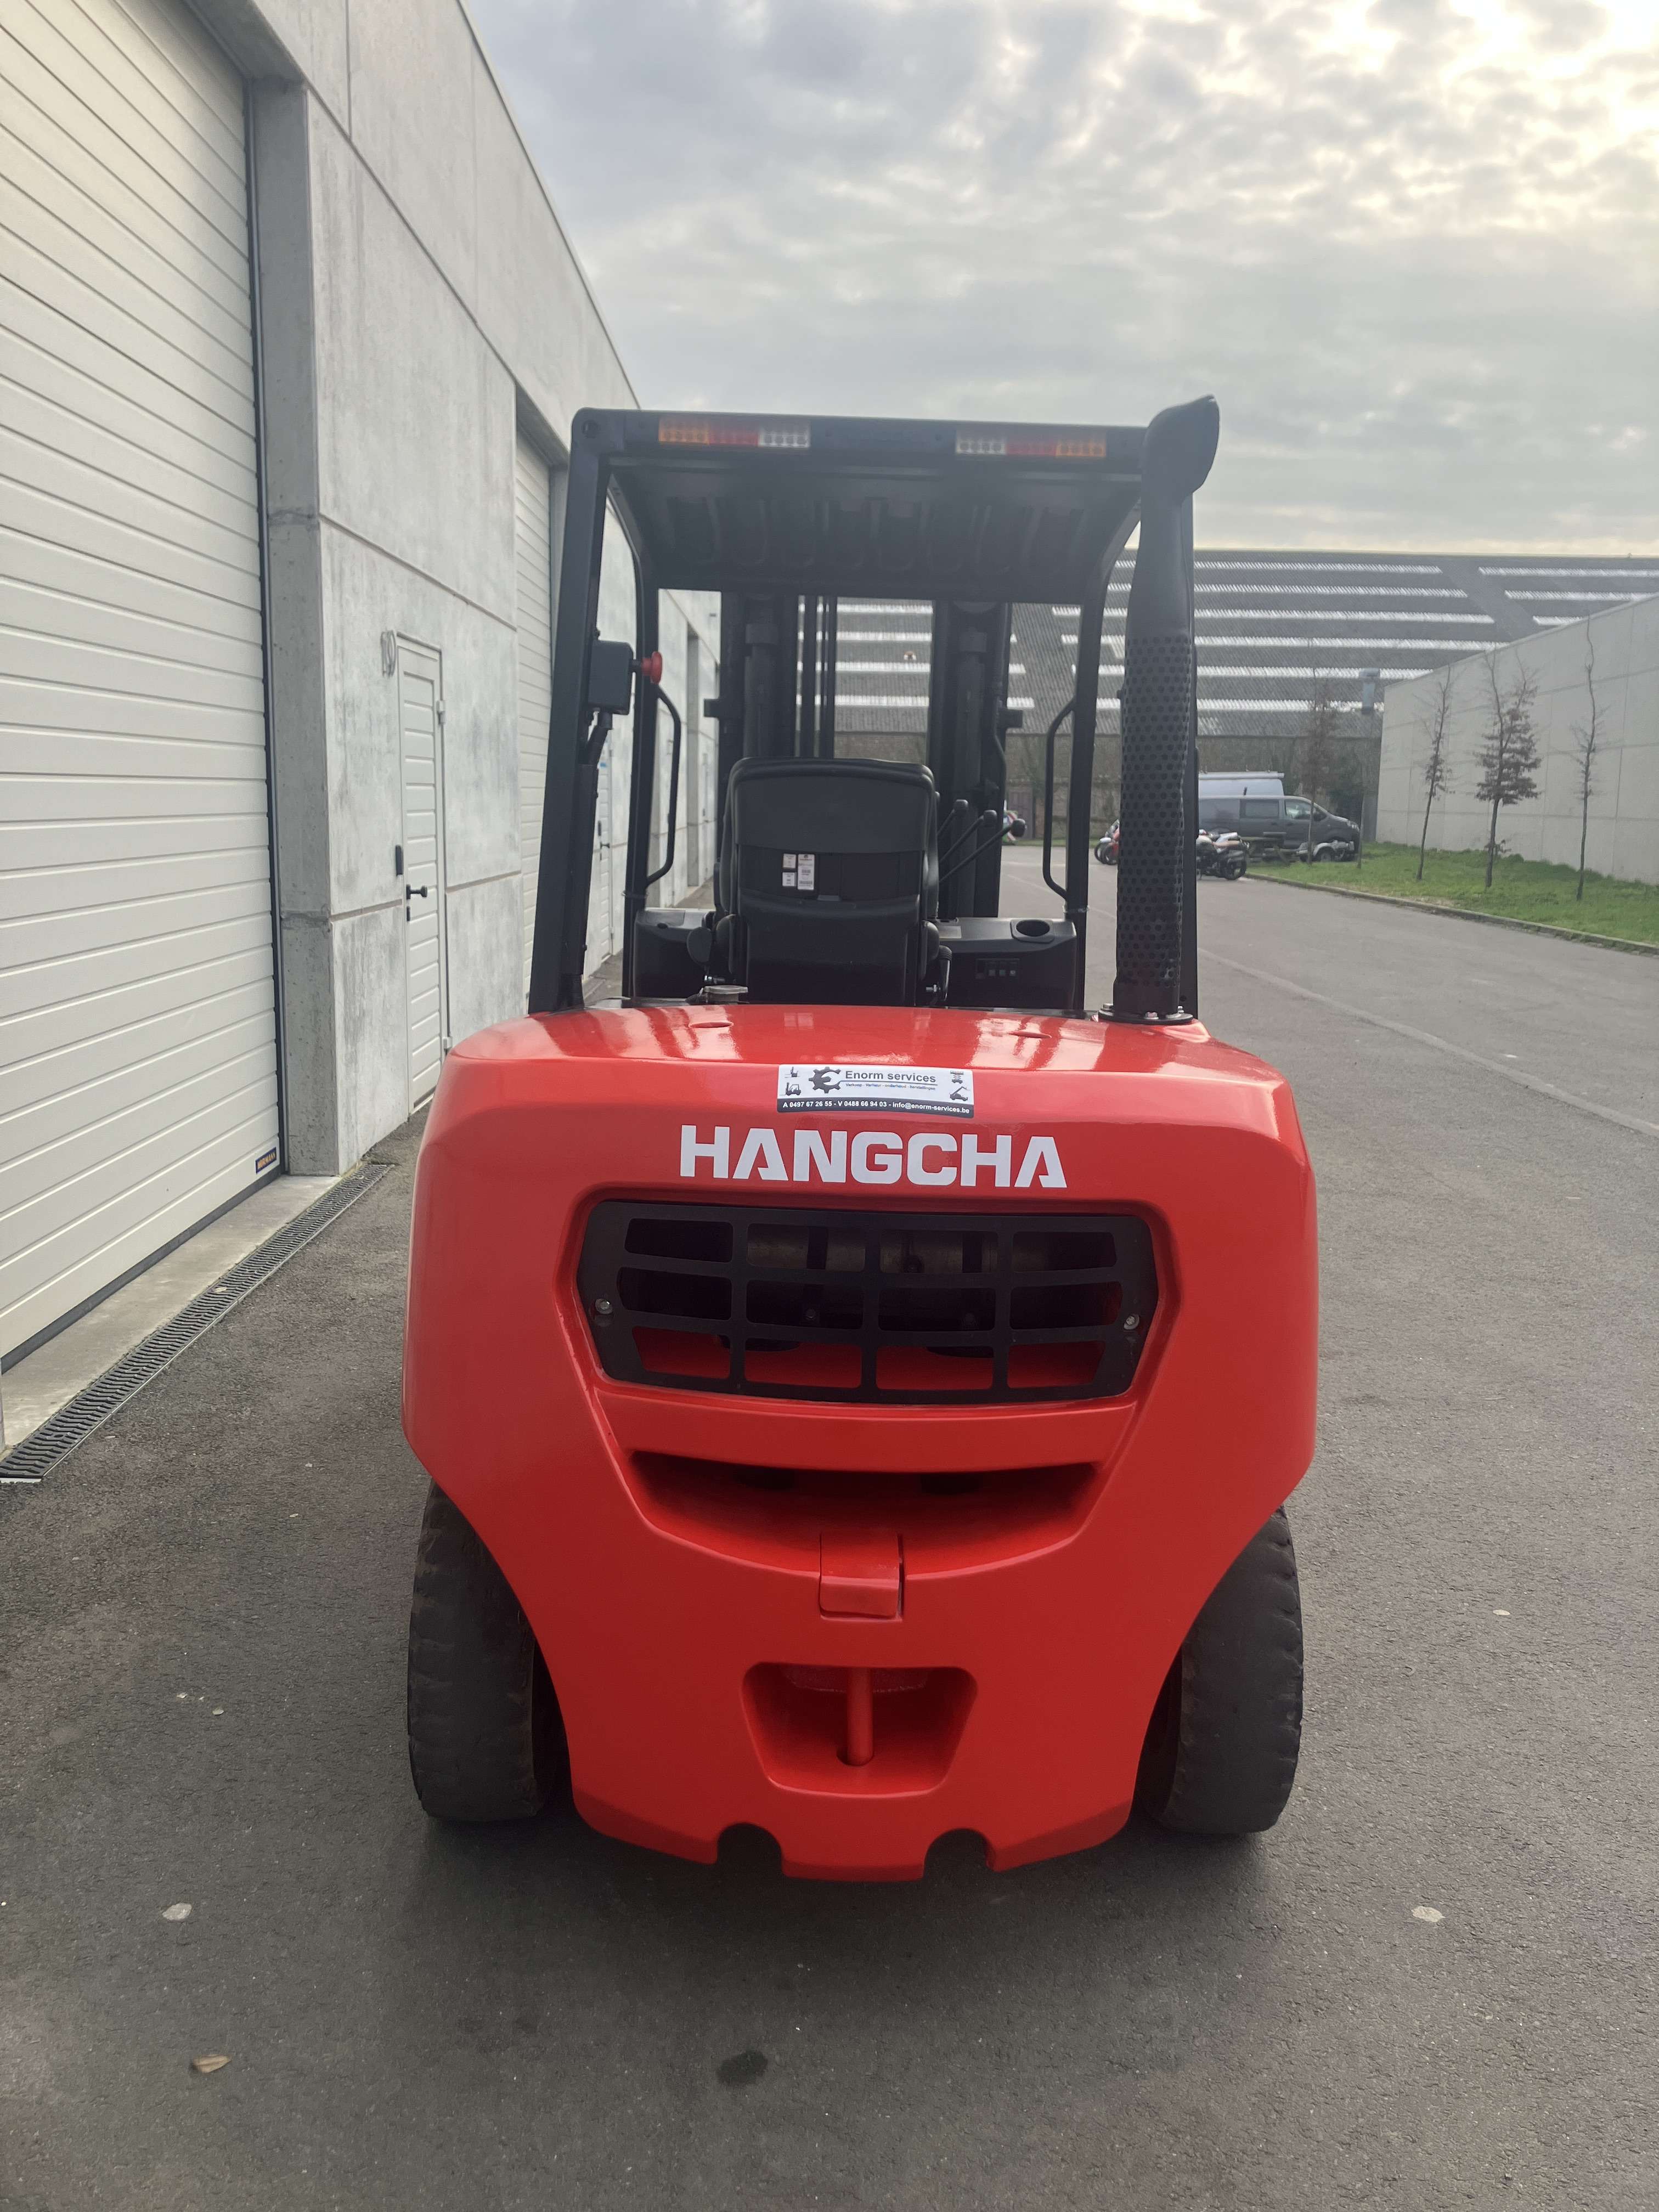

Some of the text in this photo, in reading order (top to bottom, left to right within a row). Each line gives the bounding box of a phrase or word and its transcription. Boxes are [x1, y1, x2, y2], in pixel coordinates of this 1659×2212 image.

[845, 1070, 936, 1082] Enorm services
[680, 1125, 1067, 1188] HANGCHA
